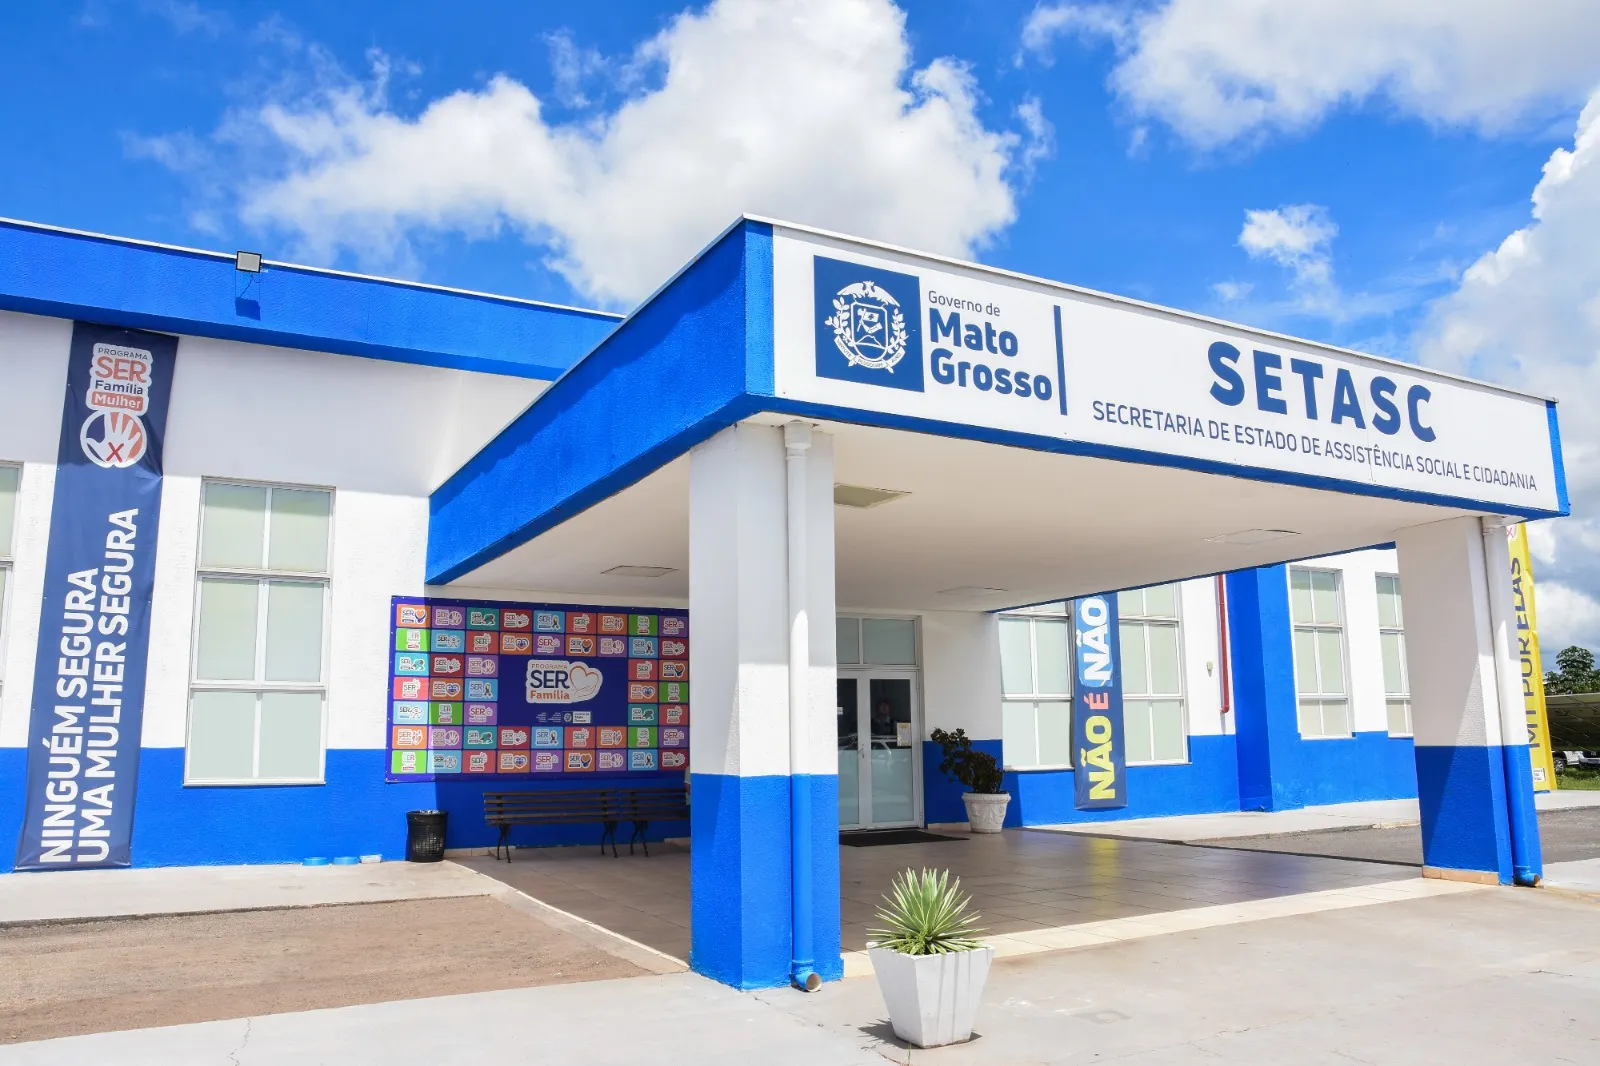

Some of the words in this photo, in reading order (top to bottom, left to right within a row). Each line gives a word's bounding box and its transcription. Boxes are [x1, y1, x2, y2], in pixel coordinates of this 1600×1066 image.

[928, 290, 983, 313] Governo
[985, 302, 1001, 317] de
[97, 347, 149, 361] PROGRAMA
[929, 307, 1019, 357] Mato
[95, 355, 147, 383] SER
[95, 379, 144, 395] Família
[930, 347, 1053, 401] Grosso
[1207, 341, 1437, 443] SETASC
[94, 393, 142, 409] Mulher
[1092, 400, 1206, 438] SECRETARIA
[1208, 419, 1231, 442] DE
[1234, 424, 1297, 452] ESTADO
[1301, 435, 1322, 456] DE
[1325, 439, 1414, 472] ASSISTÊNCIA
[1416, 455, 1462, 480] SOCIAL
[1463, 463, 1472, 480] E
[1473, 466, 1538, 492] CIDADANIA
[98, 508, 139, 636] SEGURA
[56, 567, 99, 699] SEGURA
[1076, 598, 1111, 682] NÃO
[530, 669, 570, 689] SER
[530, 690, 570, 700] Família
[1083, 692, 1109, 710] É
[85, 641, 127, 779] MULHER
[40, 705, 85, 863] NINGUÉM
[1080, 715, 1116, 800] NÃO
[77, 784, 115, 863] UMA
